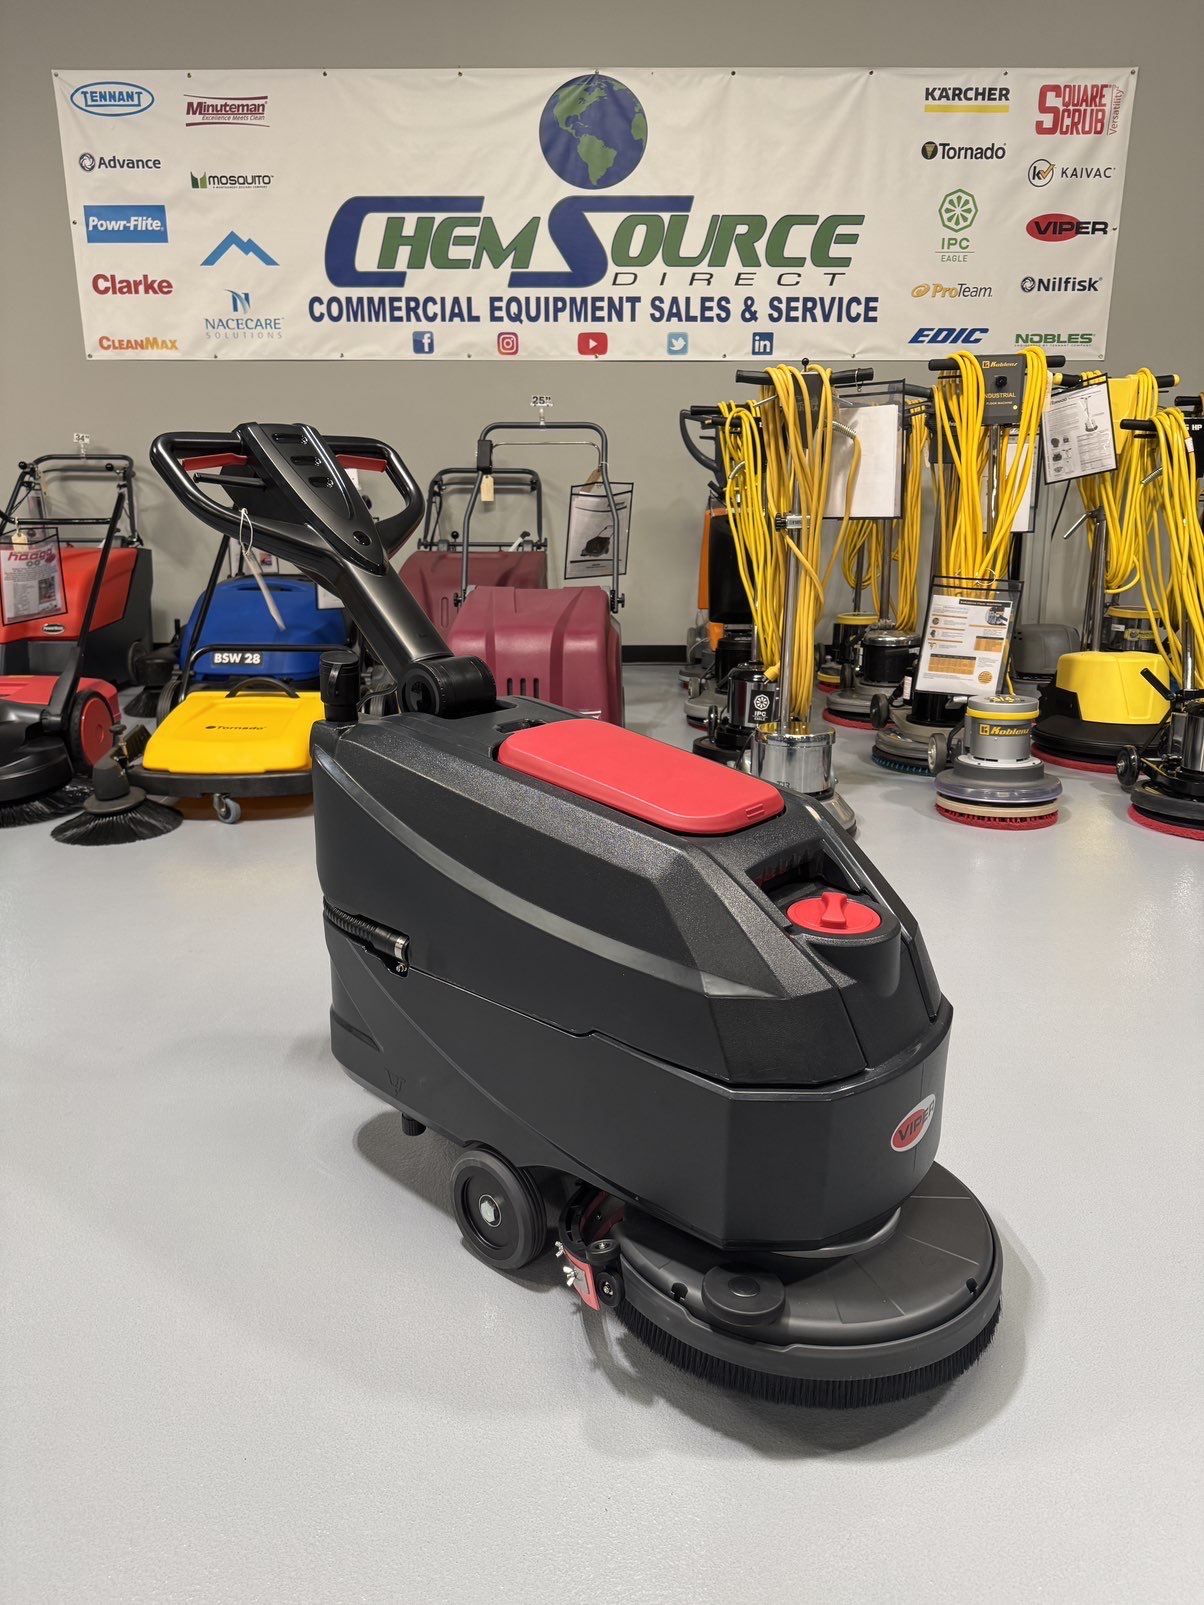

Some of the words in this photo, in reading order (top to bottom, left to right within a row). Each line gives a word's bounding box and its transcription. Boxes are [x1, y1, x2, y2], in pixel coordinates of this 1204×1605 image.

[81, 91, 143, 106] TENNANT
[925, 87, 1010, 101] KÄRCHER
[186, 102, 265, 115] Minuteman
[1109, 87, 1124, 135] Versatility
[939, 143, 1005, 159] Tornado
[98, 156, 161, 169] Advance
[1061, 167, 1112, 178] KAIVAC
[88, 216, 161, 231] Powr-Flite
[1033, 221, 1108, 235] VIPER
[941, 238, 970, 249] IPC
[92, 273, 174, 295] Clarke
[612, 272, 846, 286] DIRECT
[1037, 277, 1099, 292] Nilfisk
[931, 283, 992, 298] ProTeam
[308, 296, 480, 323] COMMERCIAL
[489, 296, 641, 324] EQUIPMENT
[650, 296, 731, 323] SALES
[740, 296, 759, 323] &
[768, 296, 879, 323] SERVICE
[205, 318, 282, 329] NACECARE
[908, 328, 989, 343] EDIC
[1015, 334, 1093, 343] NOBLES
[214, 653, 242, 663] BSW
[244, 653, 261, 664] 28
[899, 1099, 935, 1141] VIPER
